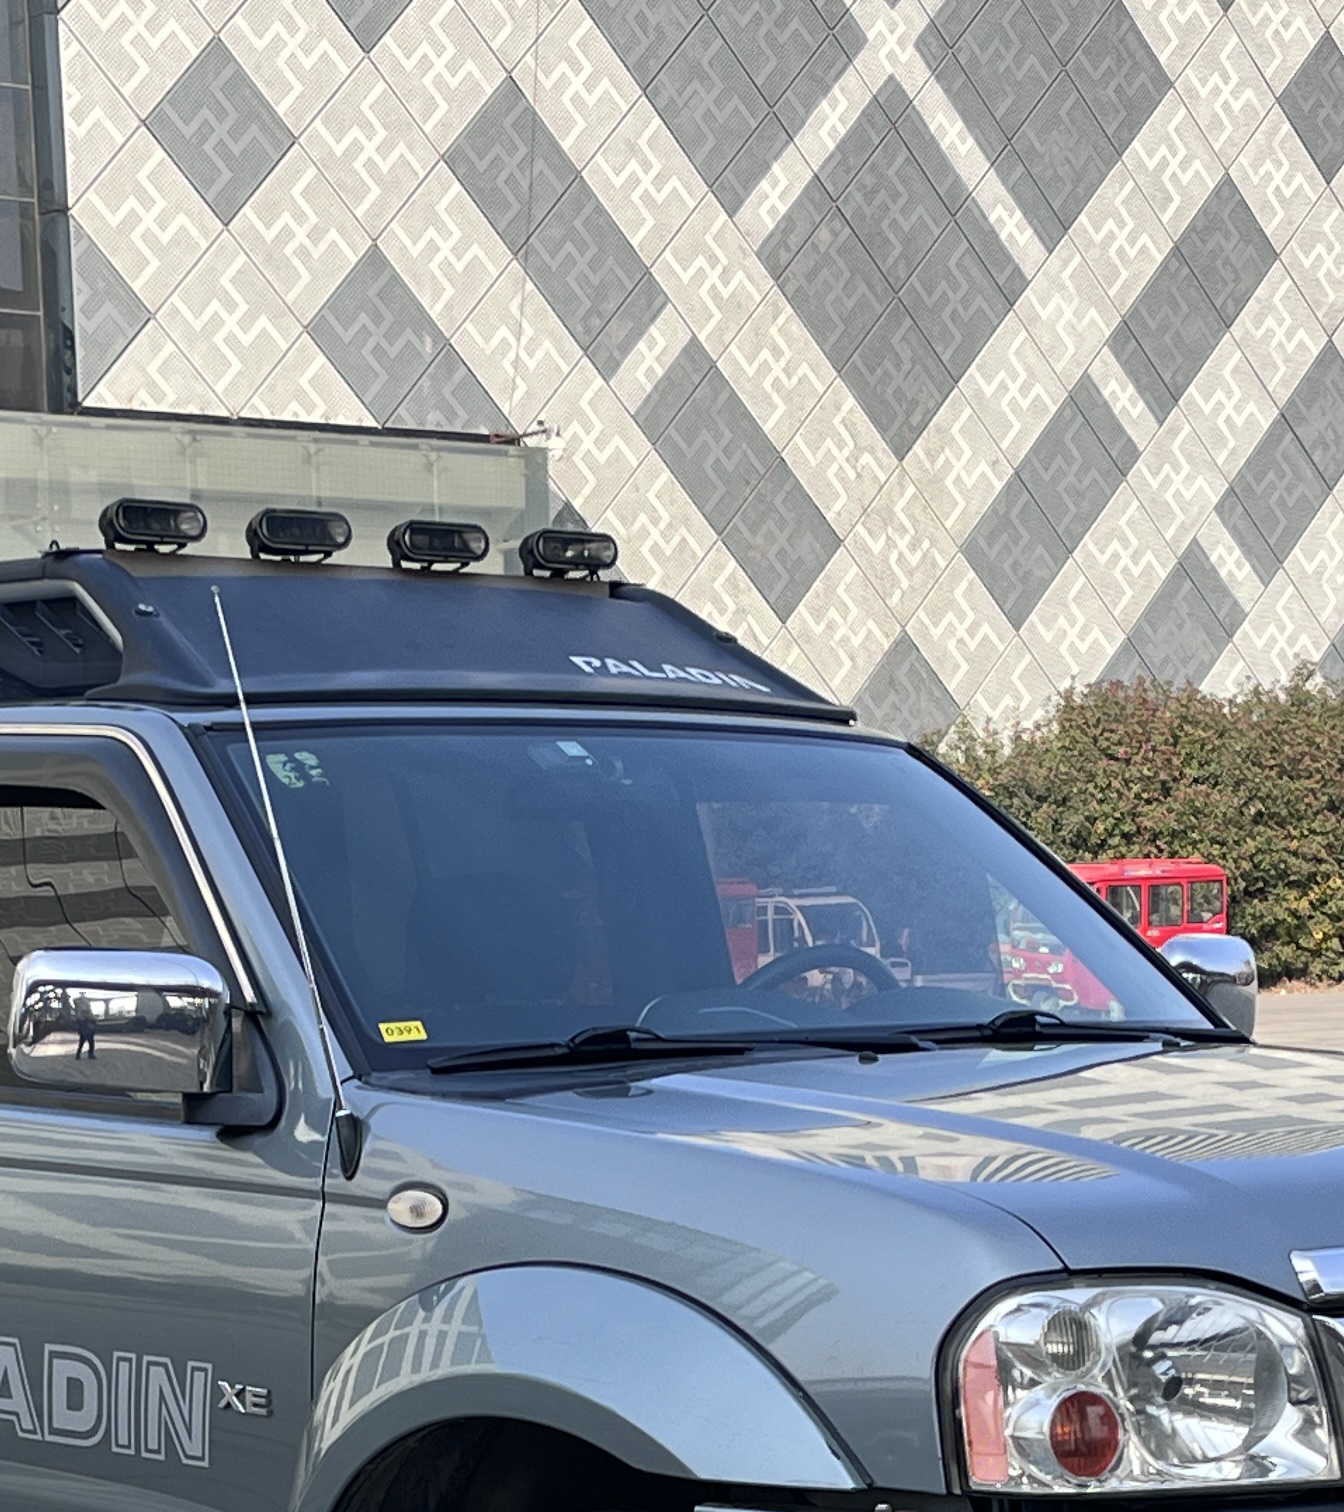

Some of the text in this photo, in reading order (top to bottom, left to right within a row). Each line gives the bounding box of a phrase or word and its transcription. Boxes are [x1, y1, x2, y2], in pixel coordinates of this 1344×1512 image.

[568, 655, 772, 694] PALADIN
[385, 1025, 422, 1037] 0391
[217, 1379, 273, 1417] XE
